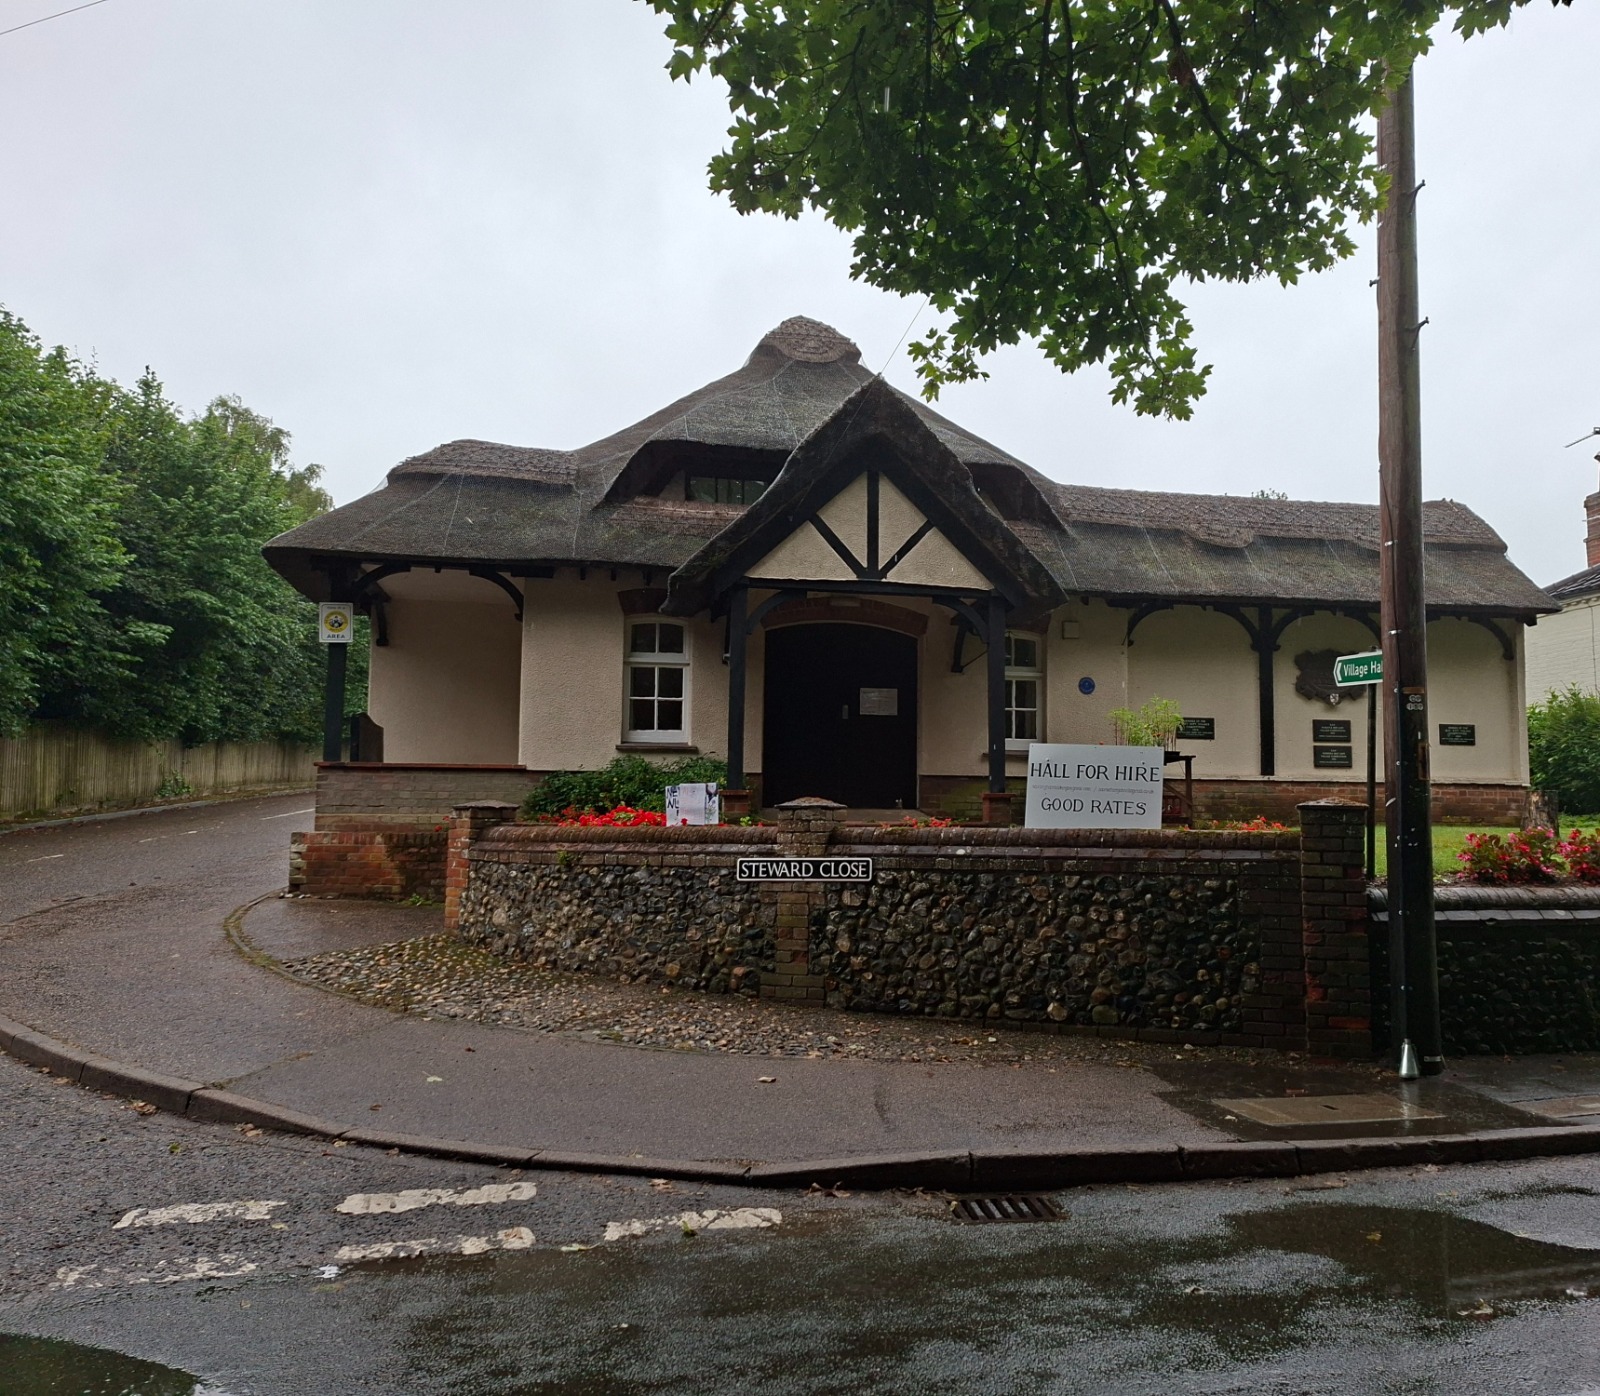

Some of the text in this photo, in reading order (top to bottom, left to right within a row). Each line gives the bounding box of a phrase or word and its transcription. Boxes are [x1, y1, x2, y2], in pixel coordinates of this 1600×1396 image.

[1343, 660, 1383, 677] Village Hal
[1030, 761, 1160, 783] HALL FOR HIRE
[1041, 797, 1147, 816] GOOD RATES
[741, 861, 868, 878] STEWARD CLOSE
